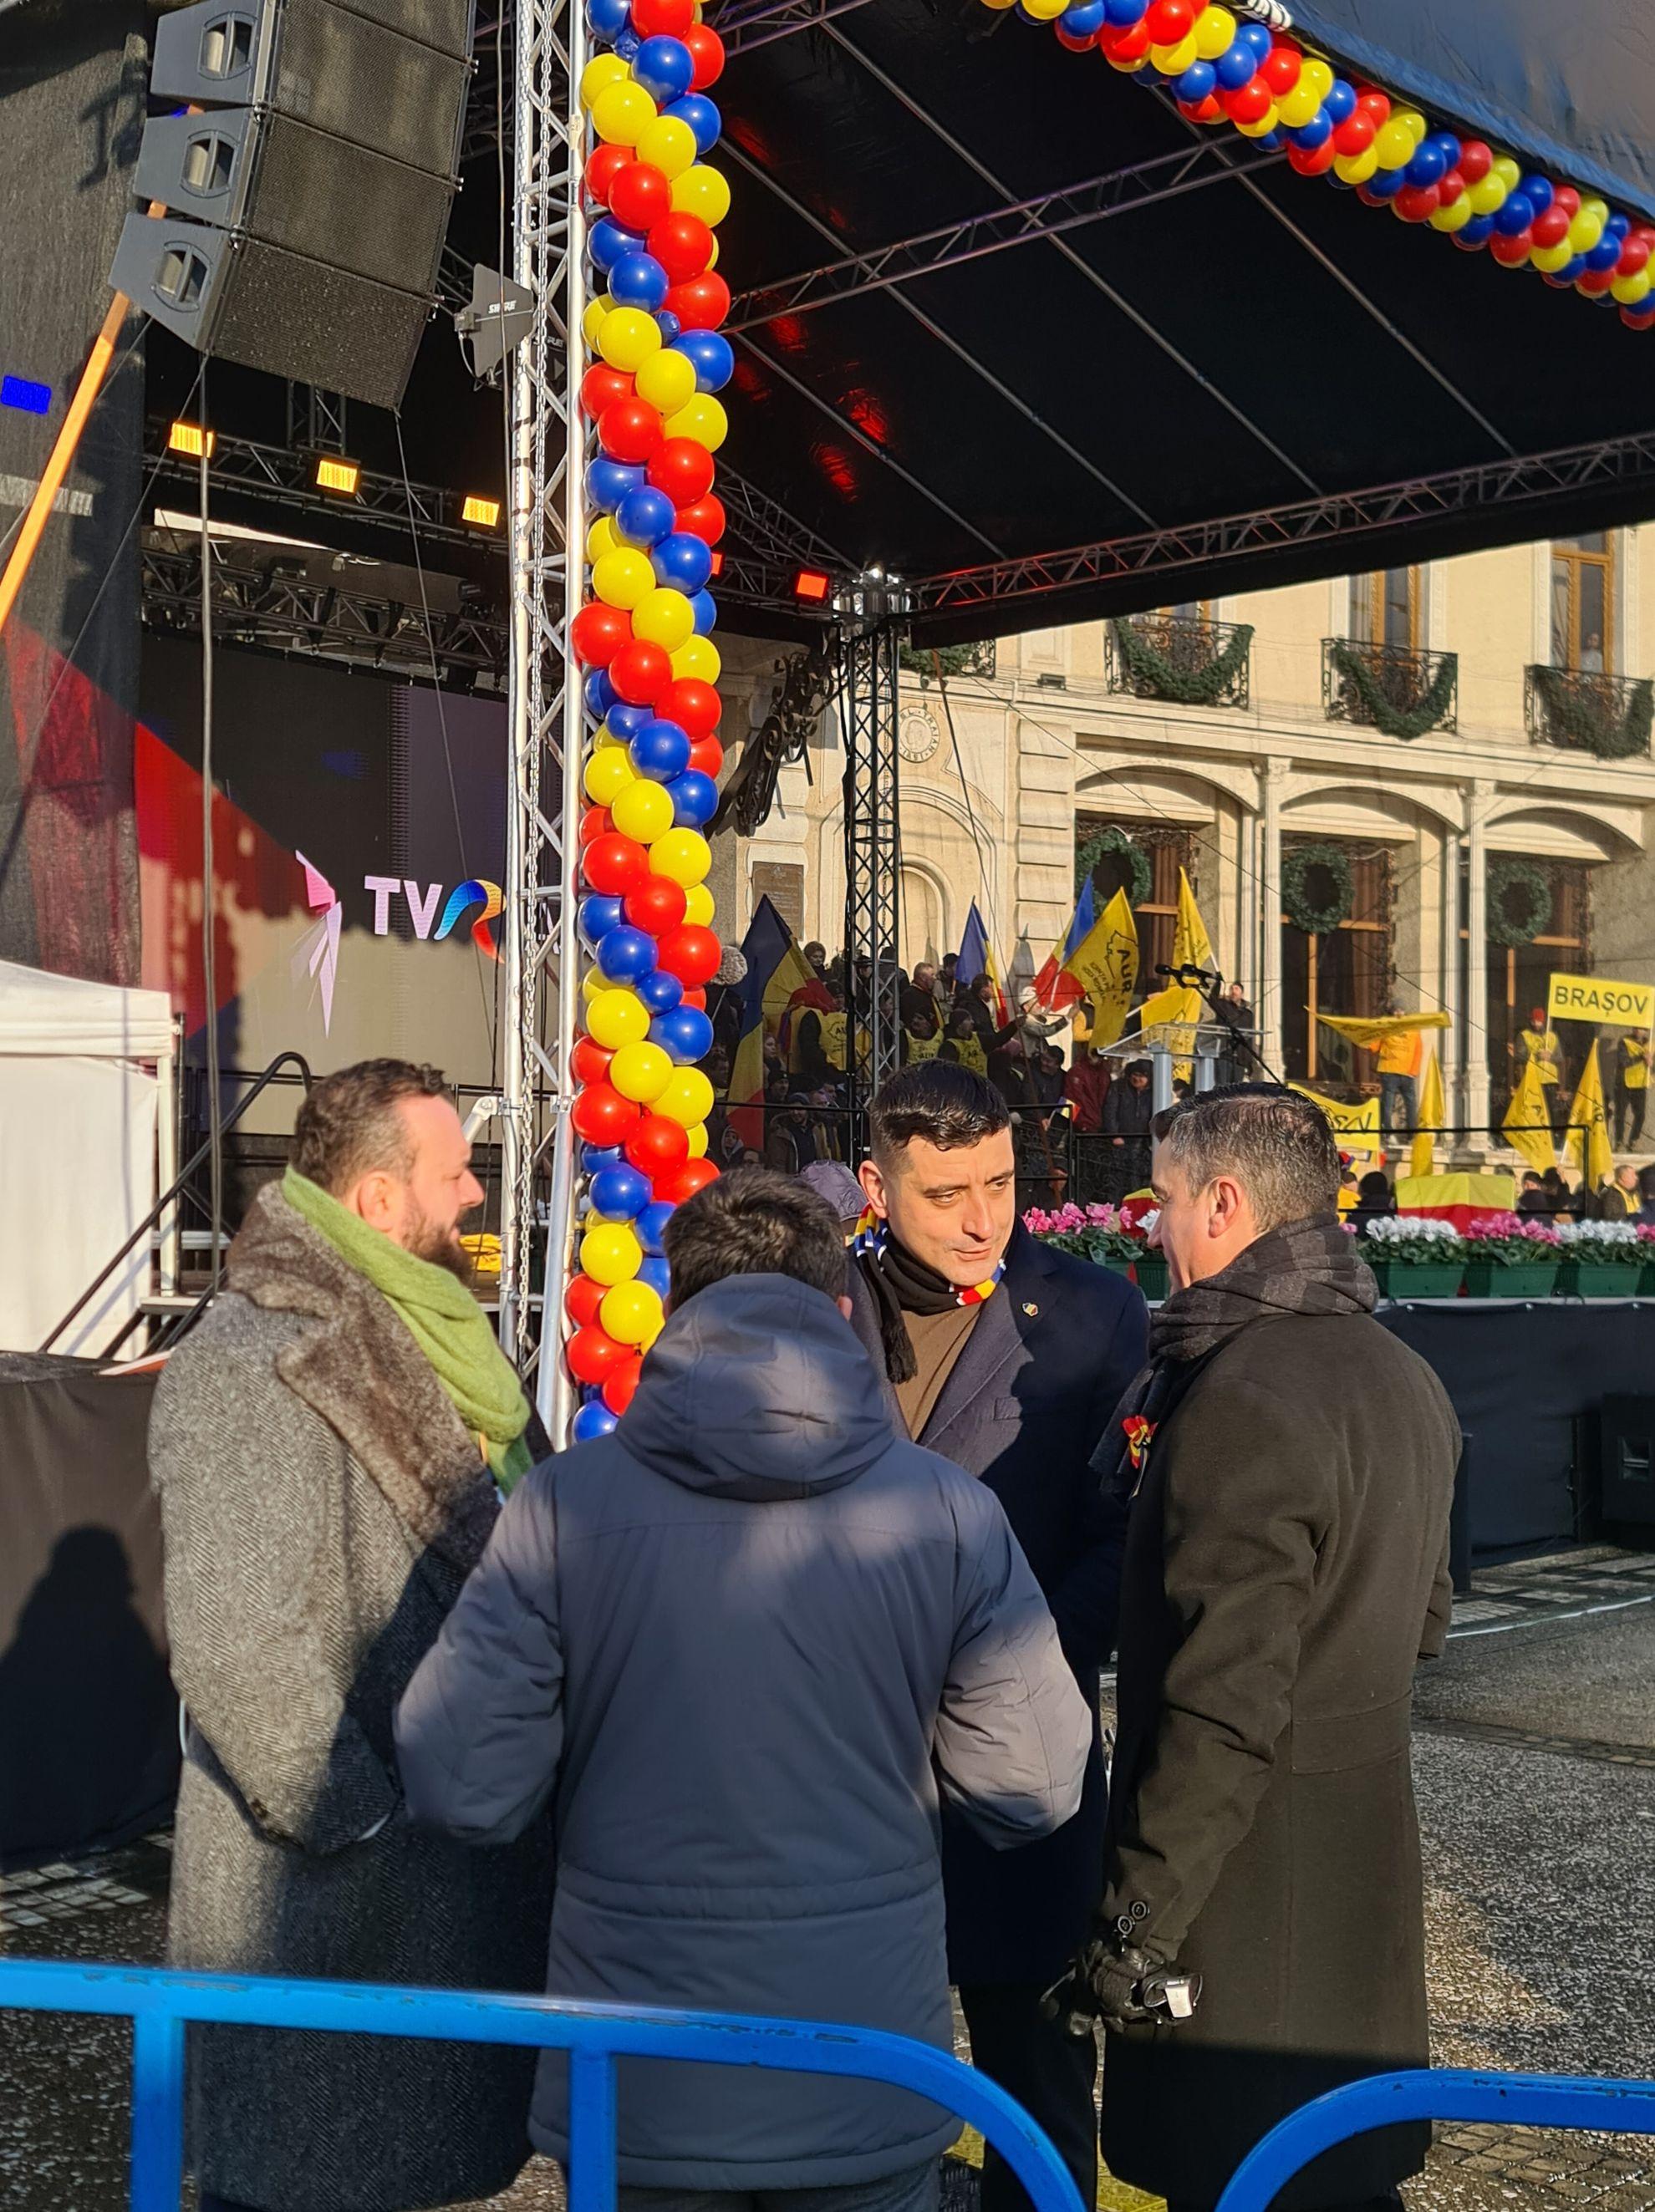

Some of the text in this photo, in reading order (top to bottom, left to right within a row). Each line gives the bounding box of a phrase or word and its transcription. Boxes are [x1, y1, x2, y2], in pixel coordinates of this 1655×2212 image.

[488, 300, 517, 313] SHRE
[1117, 948, 1133, 994] AUR
[1555, 985, 1648, 1017] BRAȘOV
